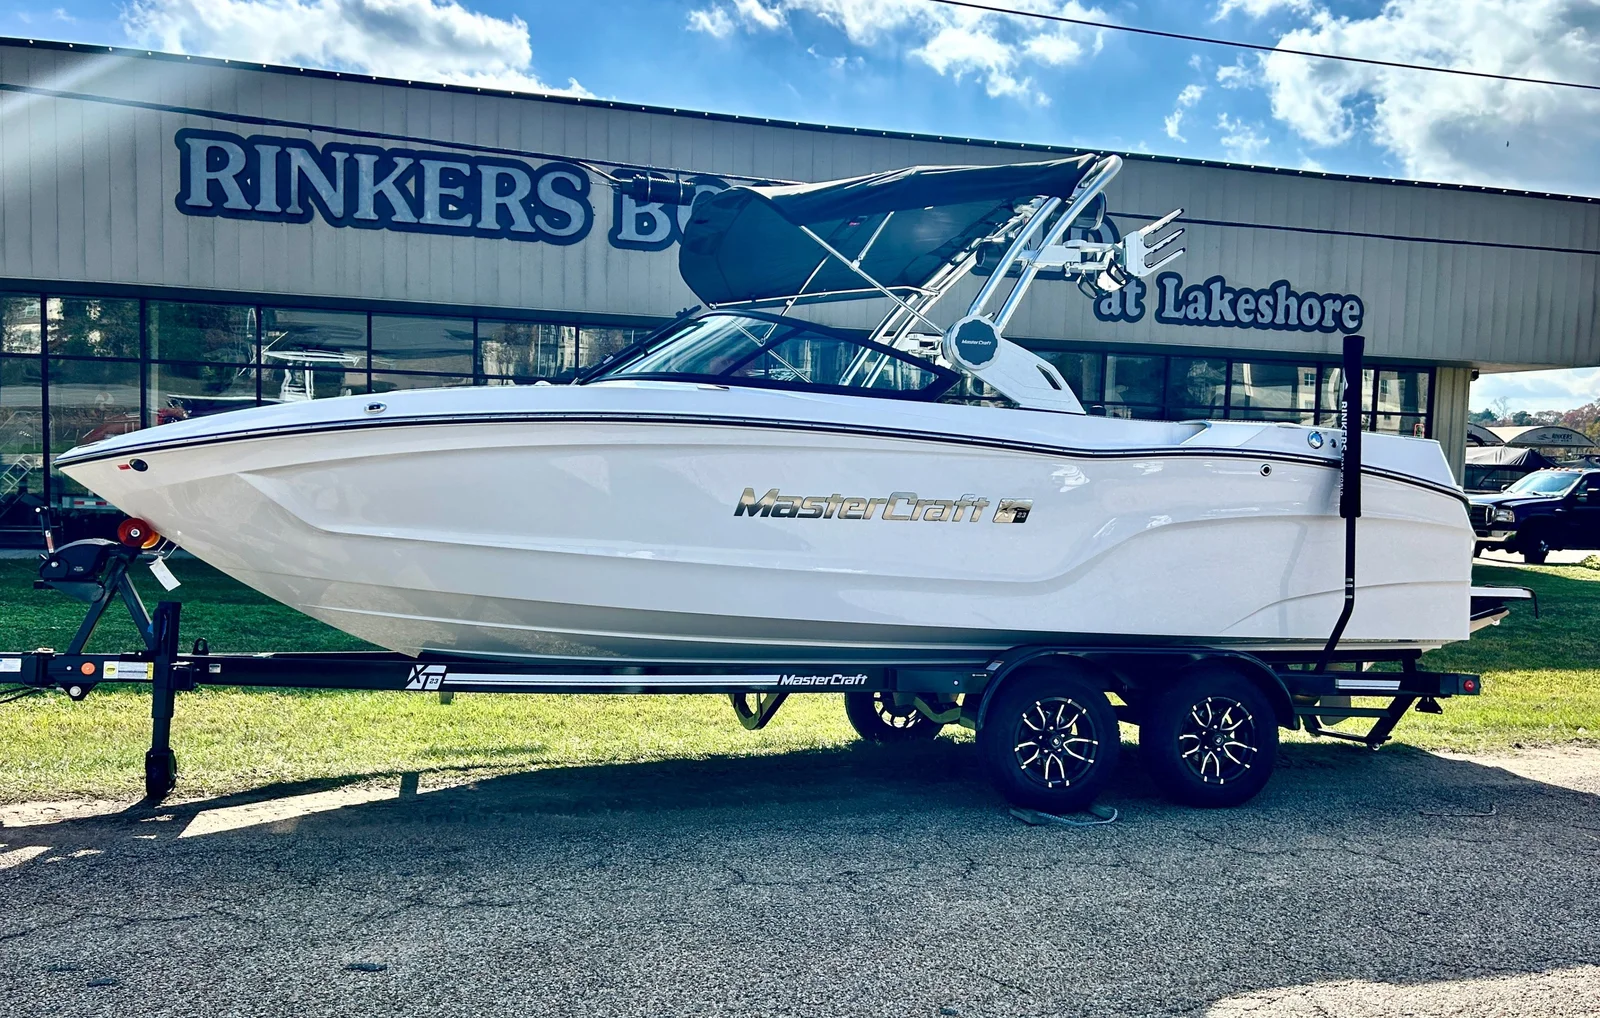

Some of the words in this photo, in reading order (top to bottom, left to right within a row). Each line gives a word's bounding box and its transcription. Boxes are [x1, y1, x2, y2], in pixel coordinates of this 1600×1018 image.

[185, 138, 585, 236] RINKERS
[1100, 279, 1142, 316] at
[1162, 278, 1361, 328] Lakeshore
[733, 487, 991, 522] MasterCraft
[779, 674, 868, 686] MasterCraft
